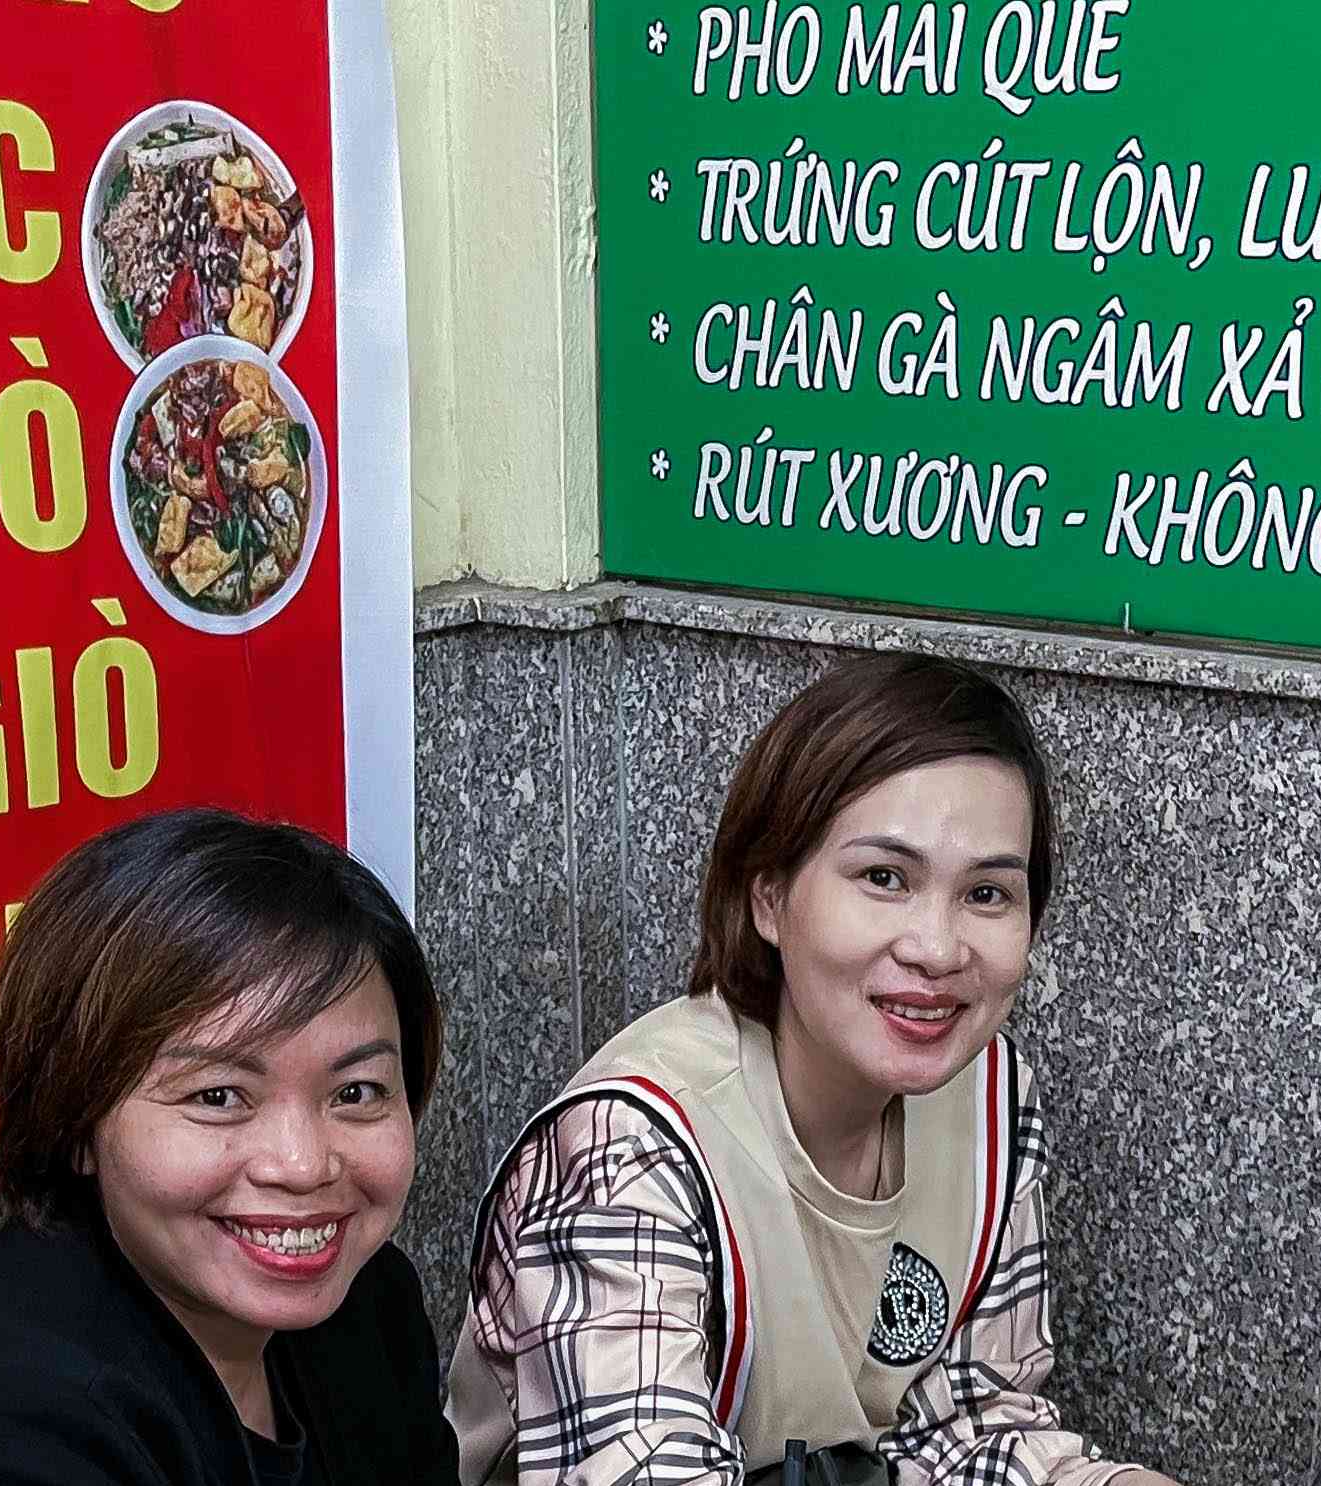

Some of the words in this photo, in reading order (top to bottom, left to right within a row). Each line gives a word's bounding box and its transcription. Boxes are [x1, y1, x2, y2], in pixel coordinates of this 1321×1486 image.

[836, 3, 967, 95] MAI
[695, 136, 899, 247] TRỨNG
[915, 137, 1052, 251] CÚT
[1054, 138, 1212, 273] LỘN,
[694, 285, 862, 392] CHÂN
[877, 291, 960, 399] GÀ
[979, 296, 1191, 411] NGÂM
[1206, 297, 1314, 420] XẢ
[693, 426, 817, 527] RÚT
[819, 450, 1048, 548] XƯƠNG
